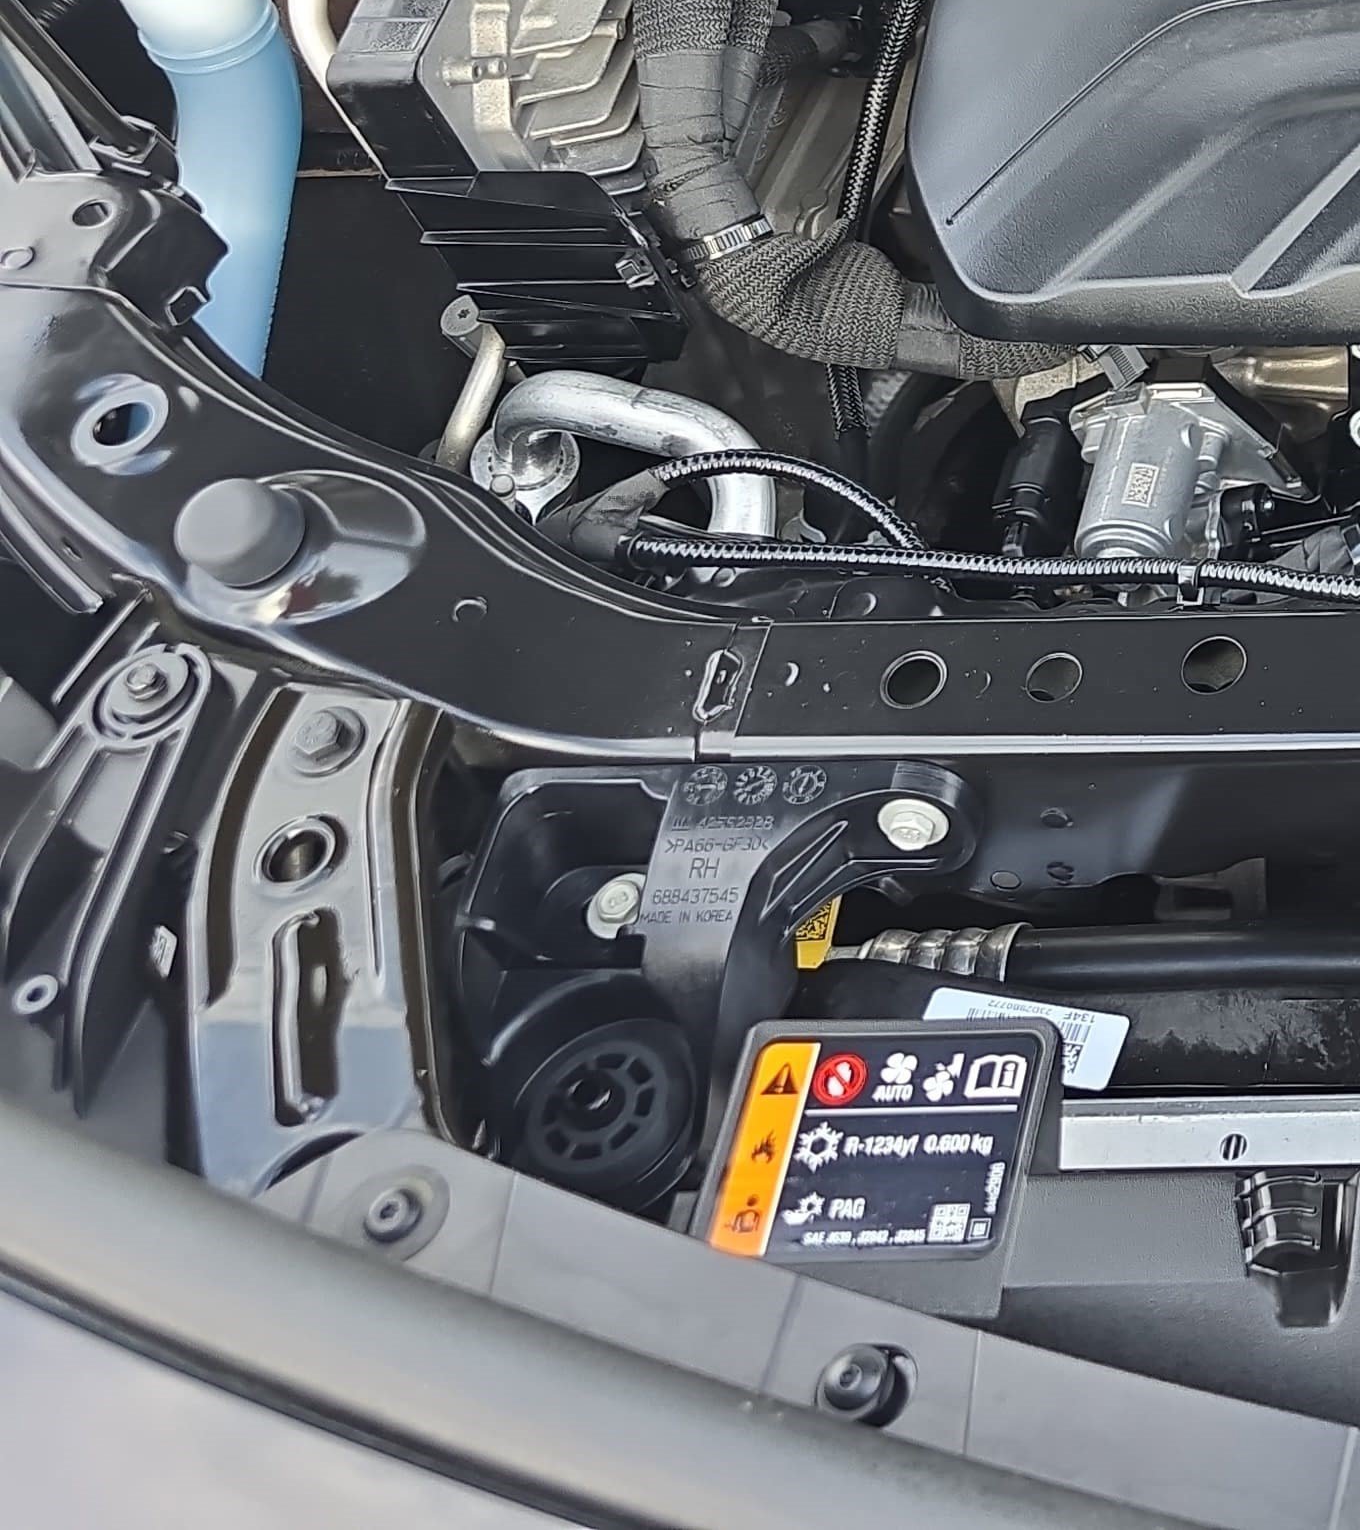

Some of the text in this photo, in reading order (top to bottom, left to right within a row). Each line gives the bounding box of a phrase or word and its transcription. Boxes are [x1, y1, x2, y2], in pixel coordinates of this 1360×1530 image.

[688, 856, 721, 879] RH
[653, 887, 739, 905] 688437545
[640, 909, 734, 924] MADE IN KOREA
[1063, 1010, 1096, 1024] 134F
[872, 1084, 914, 1102] AUTO
[923, 1133, 970, 1155] 0.600
[971, 1133, 994, 1158] kg
[829, 1197, 866, 1220] PAG
[802, 1230, 826, 1246] SAE
